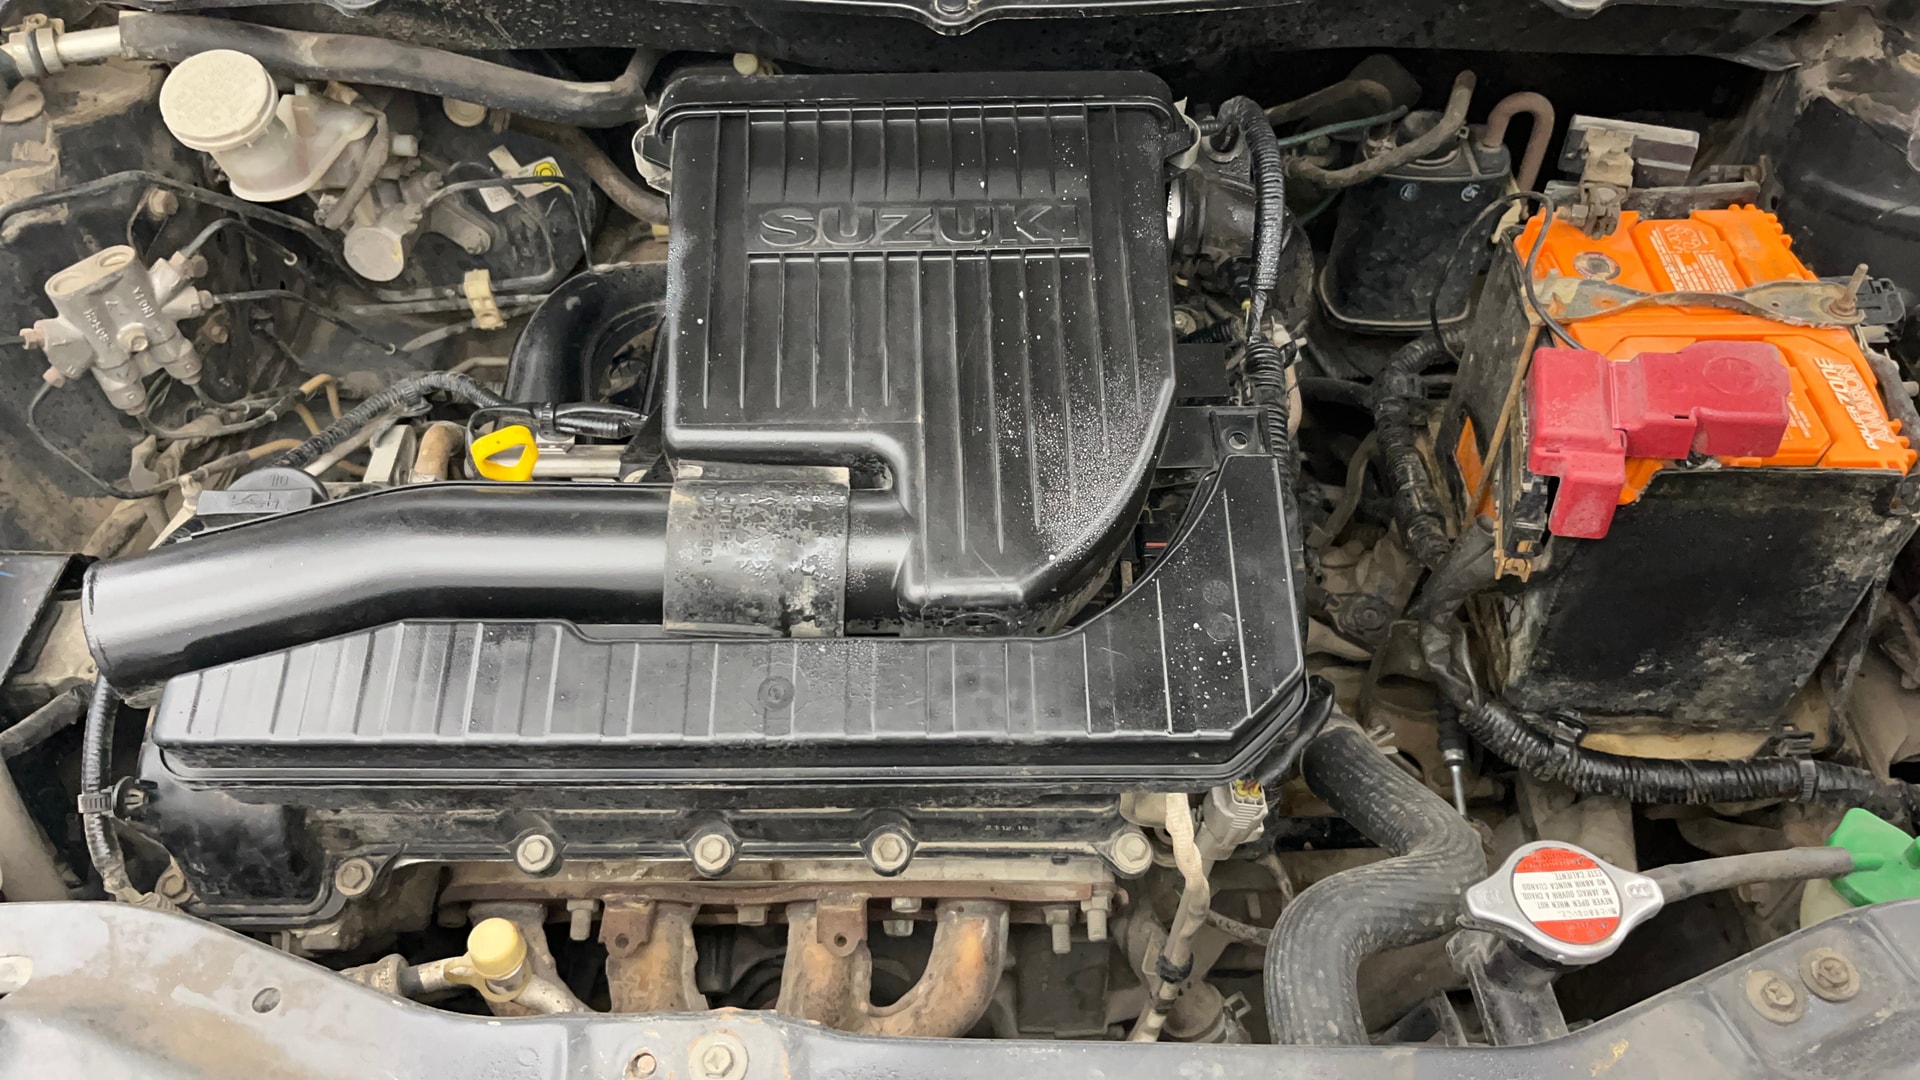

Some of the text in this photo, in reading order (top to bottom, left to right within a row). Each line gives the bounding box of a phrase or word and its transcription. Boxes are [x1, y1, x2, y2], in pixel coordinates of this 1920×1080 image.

[759, 206, 1079, 247] SUZUKI
[1832, 363, 1896, 444] AMARON
[1521, 883, 1548, 891] CUANDO
[1550, 881, 1573, 890] NUNCA
[1575, 880, 1595, 888] ABRIR
[1551, 890, 1574, 899] OUVRIR
[1576, 889, 1599, 898] JAMAIS
[1600, 888, 1610, 896] NE
[1551, 900, 1570, 909] WHEN
[1572, 899, 1590, 908] OPEN
[1591, 897, 1614, 906] NEVER
